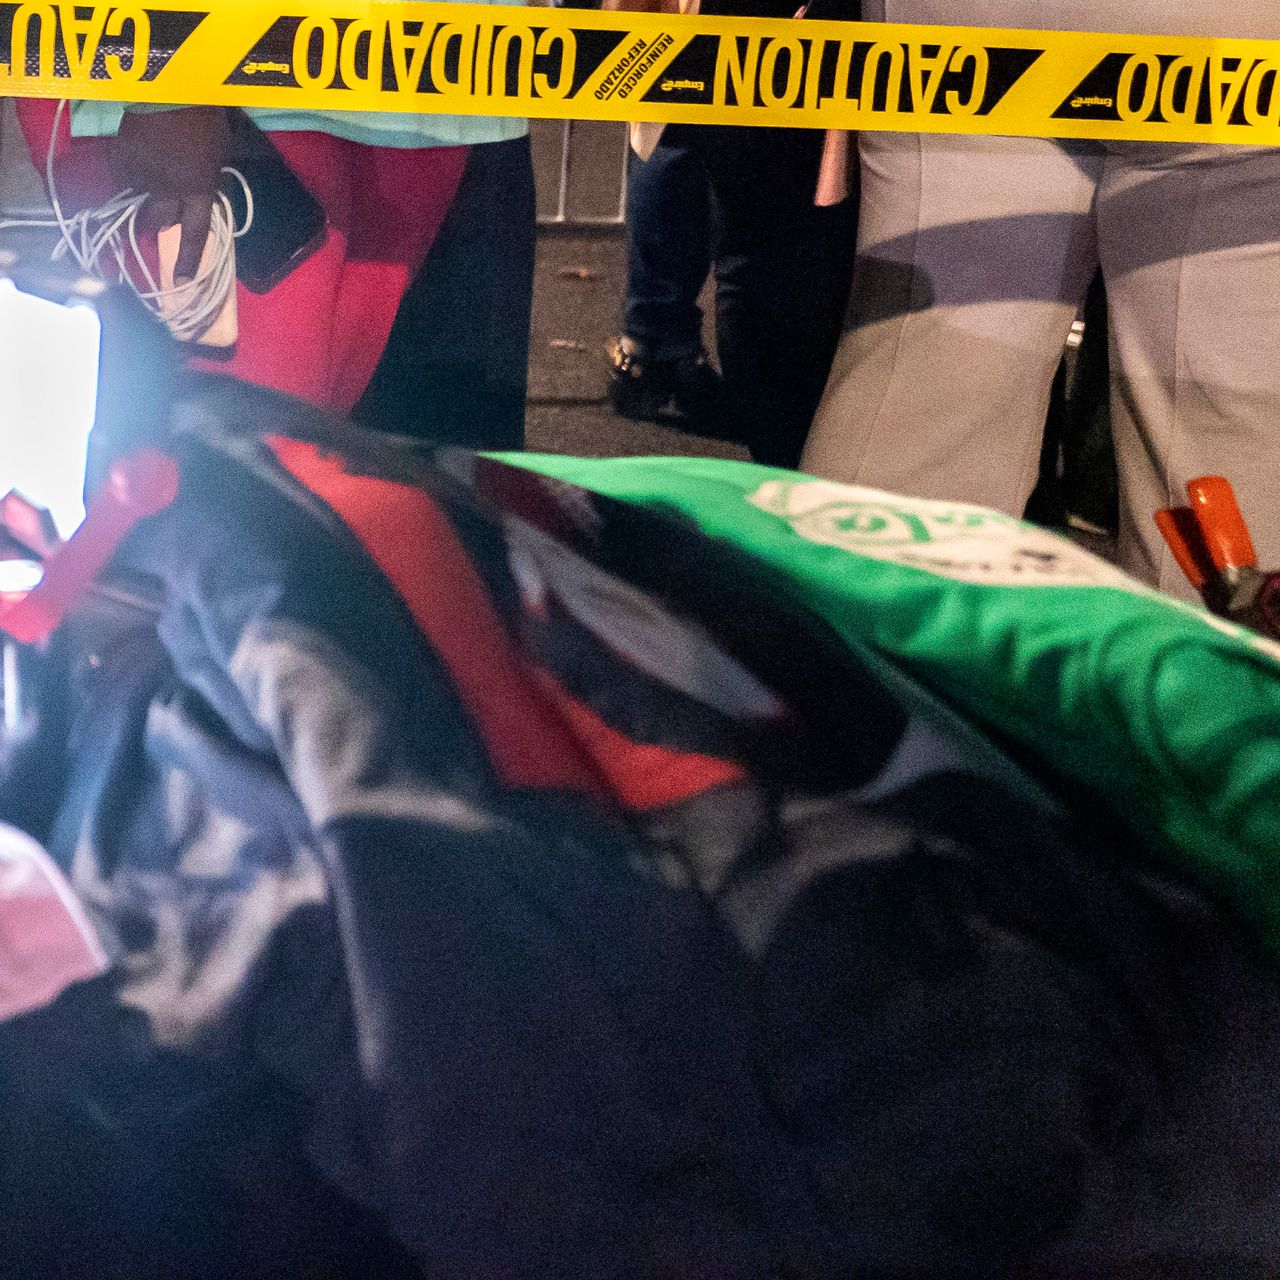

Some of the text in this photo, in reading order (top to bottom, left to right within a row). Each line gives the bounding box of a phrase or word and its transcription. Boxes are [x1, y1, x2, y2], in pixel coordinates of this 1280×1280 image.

[292, 16, 576, 99] CUIDADO
[594, 38, 647, 101] REFORZADO
[618, 34, 674, 99] REINFORCED
[714, 35, 988, 115] CAUTION
